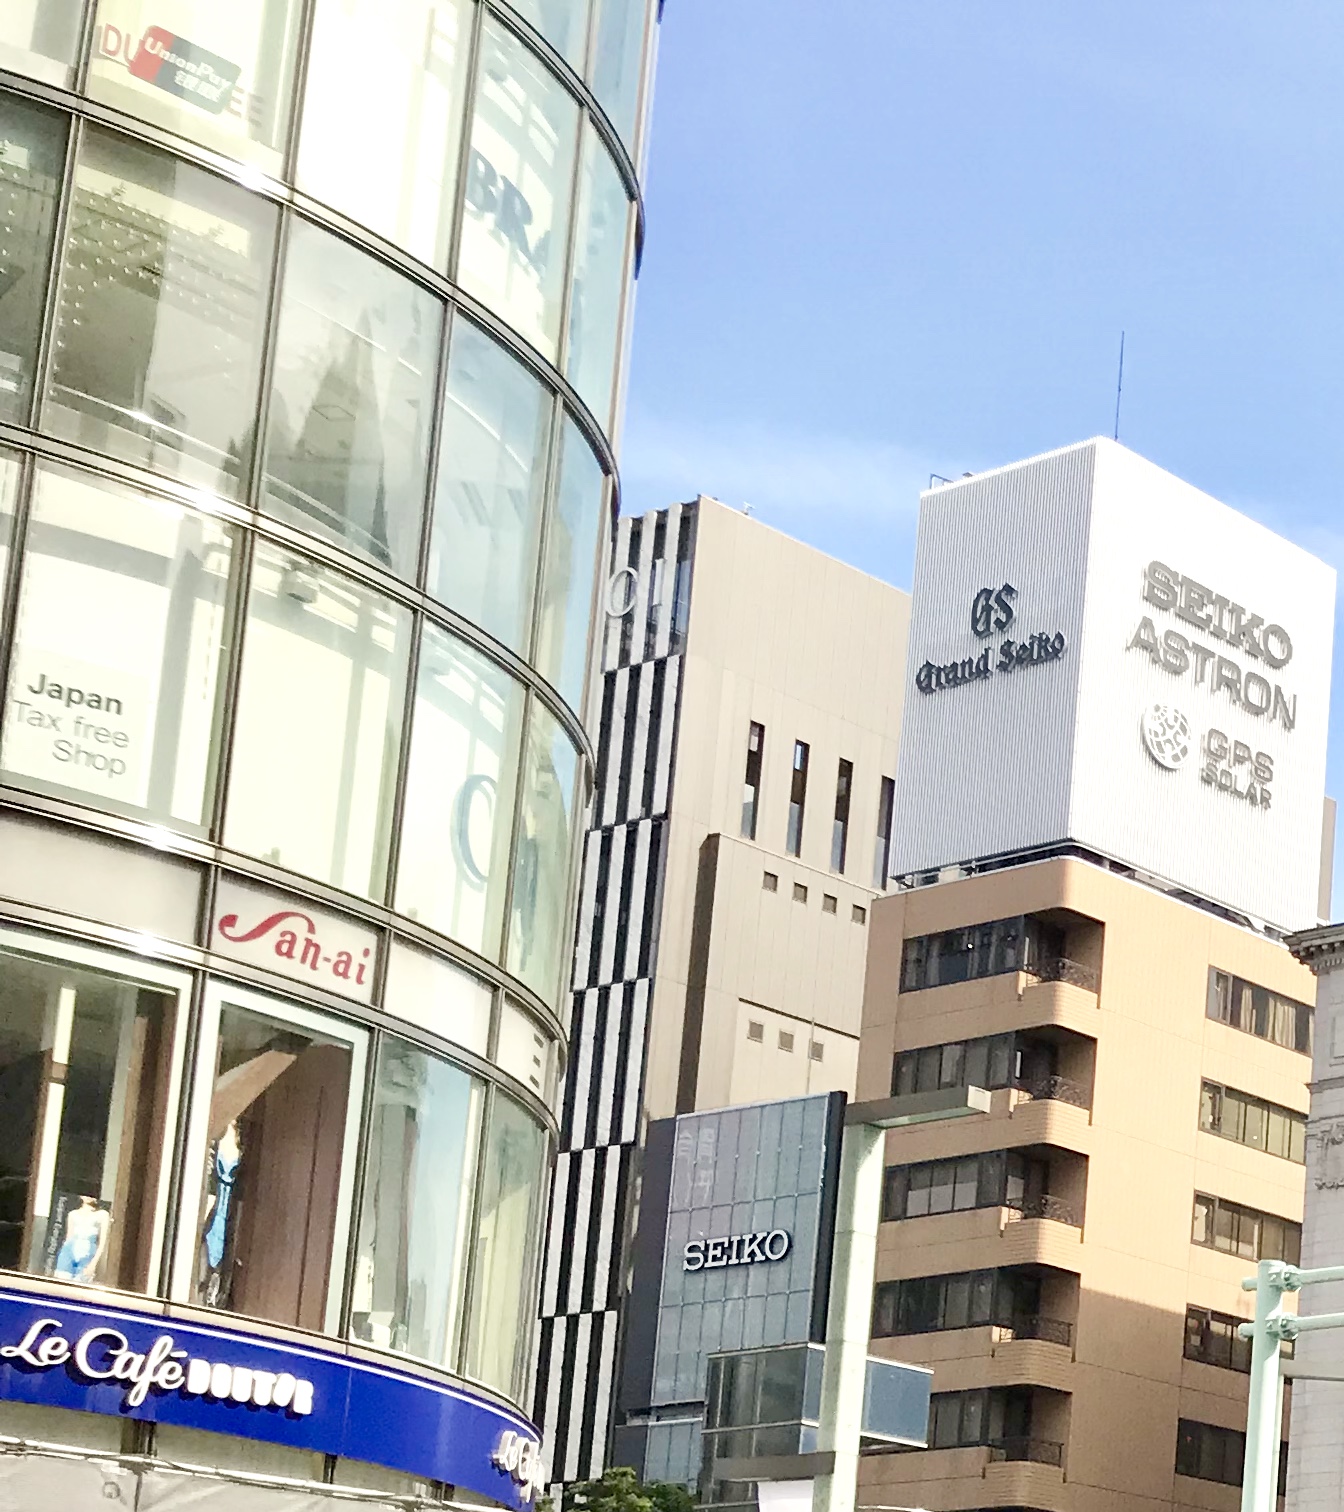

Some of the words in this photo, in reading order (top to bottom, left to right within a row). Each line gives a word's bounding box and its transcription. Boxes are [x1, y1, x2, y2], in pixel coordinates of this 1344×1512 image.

[144, 37, 232, 90] UnionPay
[1142, 560, 1293, 670] SEIKO
[916, 646, 993, 696] Grand
[996, 631, 1067, 673] Seiko
[1126, 616, 1297, 732] ASTRON
[27, 673, 123, 716] Japan
[13, 699, 62, 732] Tax
[73, 715, 129, 748] free
[52, 739, 127, 779] Shop
[1203, 728, 1274, 784] GPS
[1200, 762, 1272, 810] SOLAR
[218, 910, 376, 987] San-ai
[682, 1228, 790, 1271] SEIKO
[0, 1318, 71, 1367] Le
[74, 1327, 189, 1407] Café
